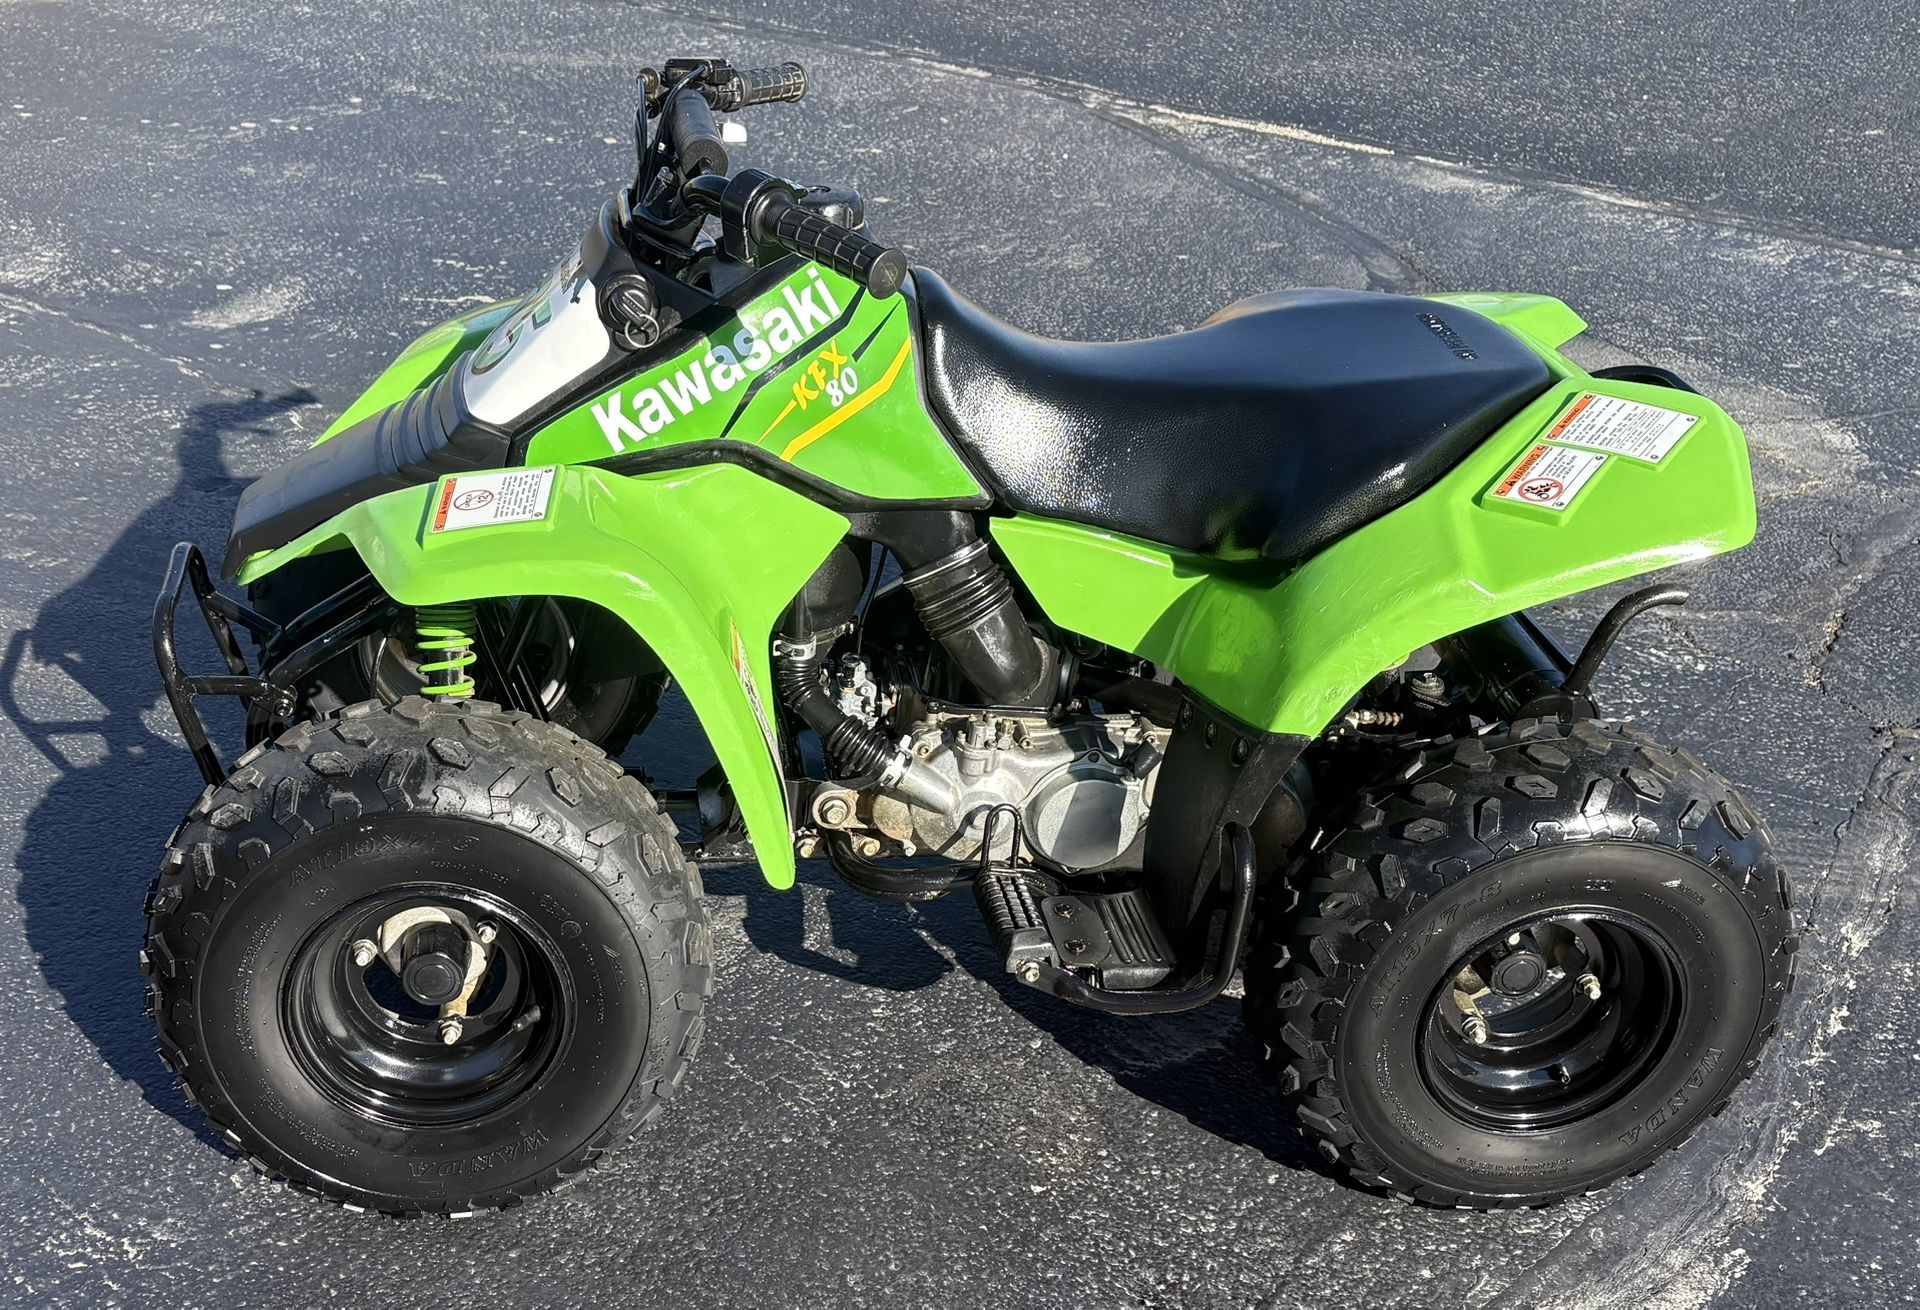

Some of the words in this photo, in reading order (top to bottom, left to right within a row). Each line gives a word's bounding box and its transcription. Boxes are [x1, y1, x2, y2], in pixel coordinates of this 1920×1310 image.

[590, 267, 843, 454] Kawasaki
[791, 339, 851, 411] KFX
[824, 367, 859, 409] 80
[1512, 453, 1541, 481] WARNING
[1617, 1046, 1725, 1147] WANDA
[408, 1129, 550, 1177] WANDA
